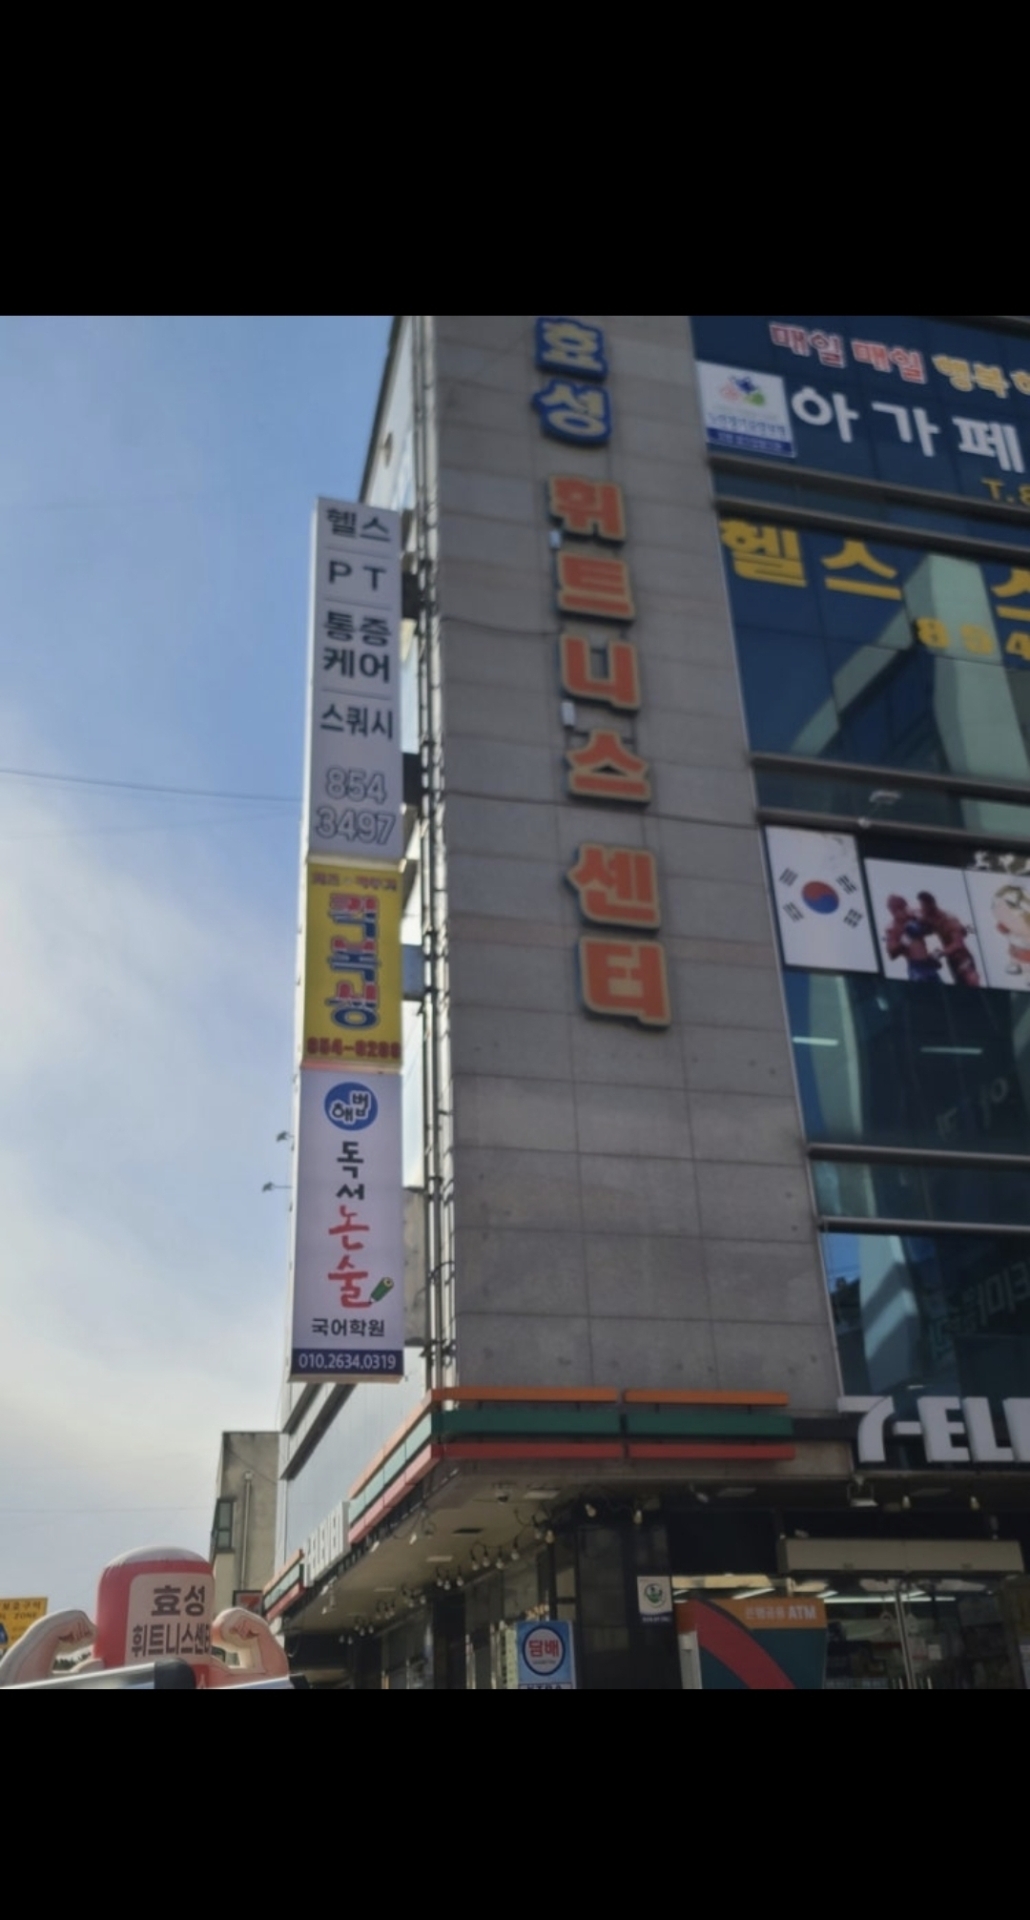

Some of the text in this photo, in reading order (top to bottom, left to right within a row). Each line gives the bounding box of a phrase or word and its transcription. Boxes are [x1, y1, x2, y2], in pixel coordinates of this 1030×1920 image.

[769, 321, 846, 369] 매일
[850, 339, 928, 385] 매일
[327, 508, 391, 543] 헬스
[323, 611, 392, 647] 통증
[323, 647, 390, 682] 케어
[534, 317, 672, 1030] 효성 휘트니스 센터
[320, 703, 393, 740] 스쿼시
[325, 767, 388, 805] 854
[315, 805, 397, 846] 3497
[331, 1091, 370, 1123] 해법
[312, 1318, 386, 1338] 국어학원
[298, 1353, 397, 1370] 010.2634.0319
[151, 1585, 205, 1617] 효성
[788, 1605, 817, 1620] ATM
[529, 1639, 561, 1657] 담배
